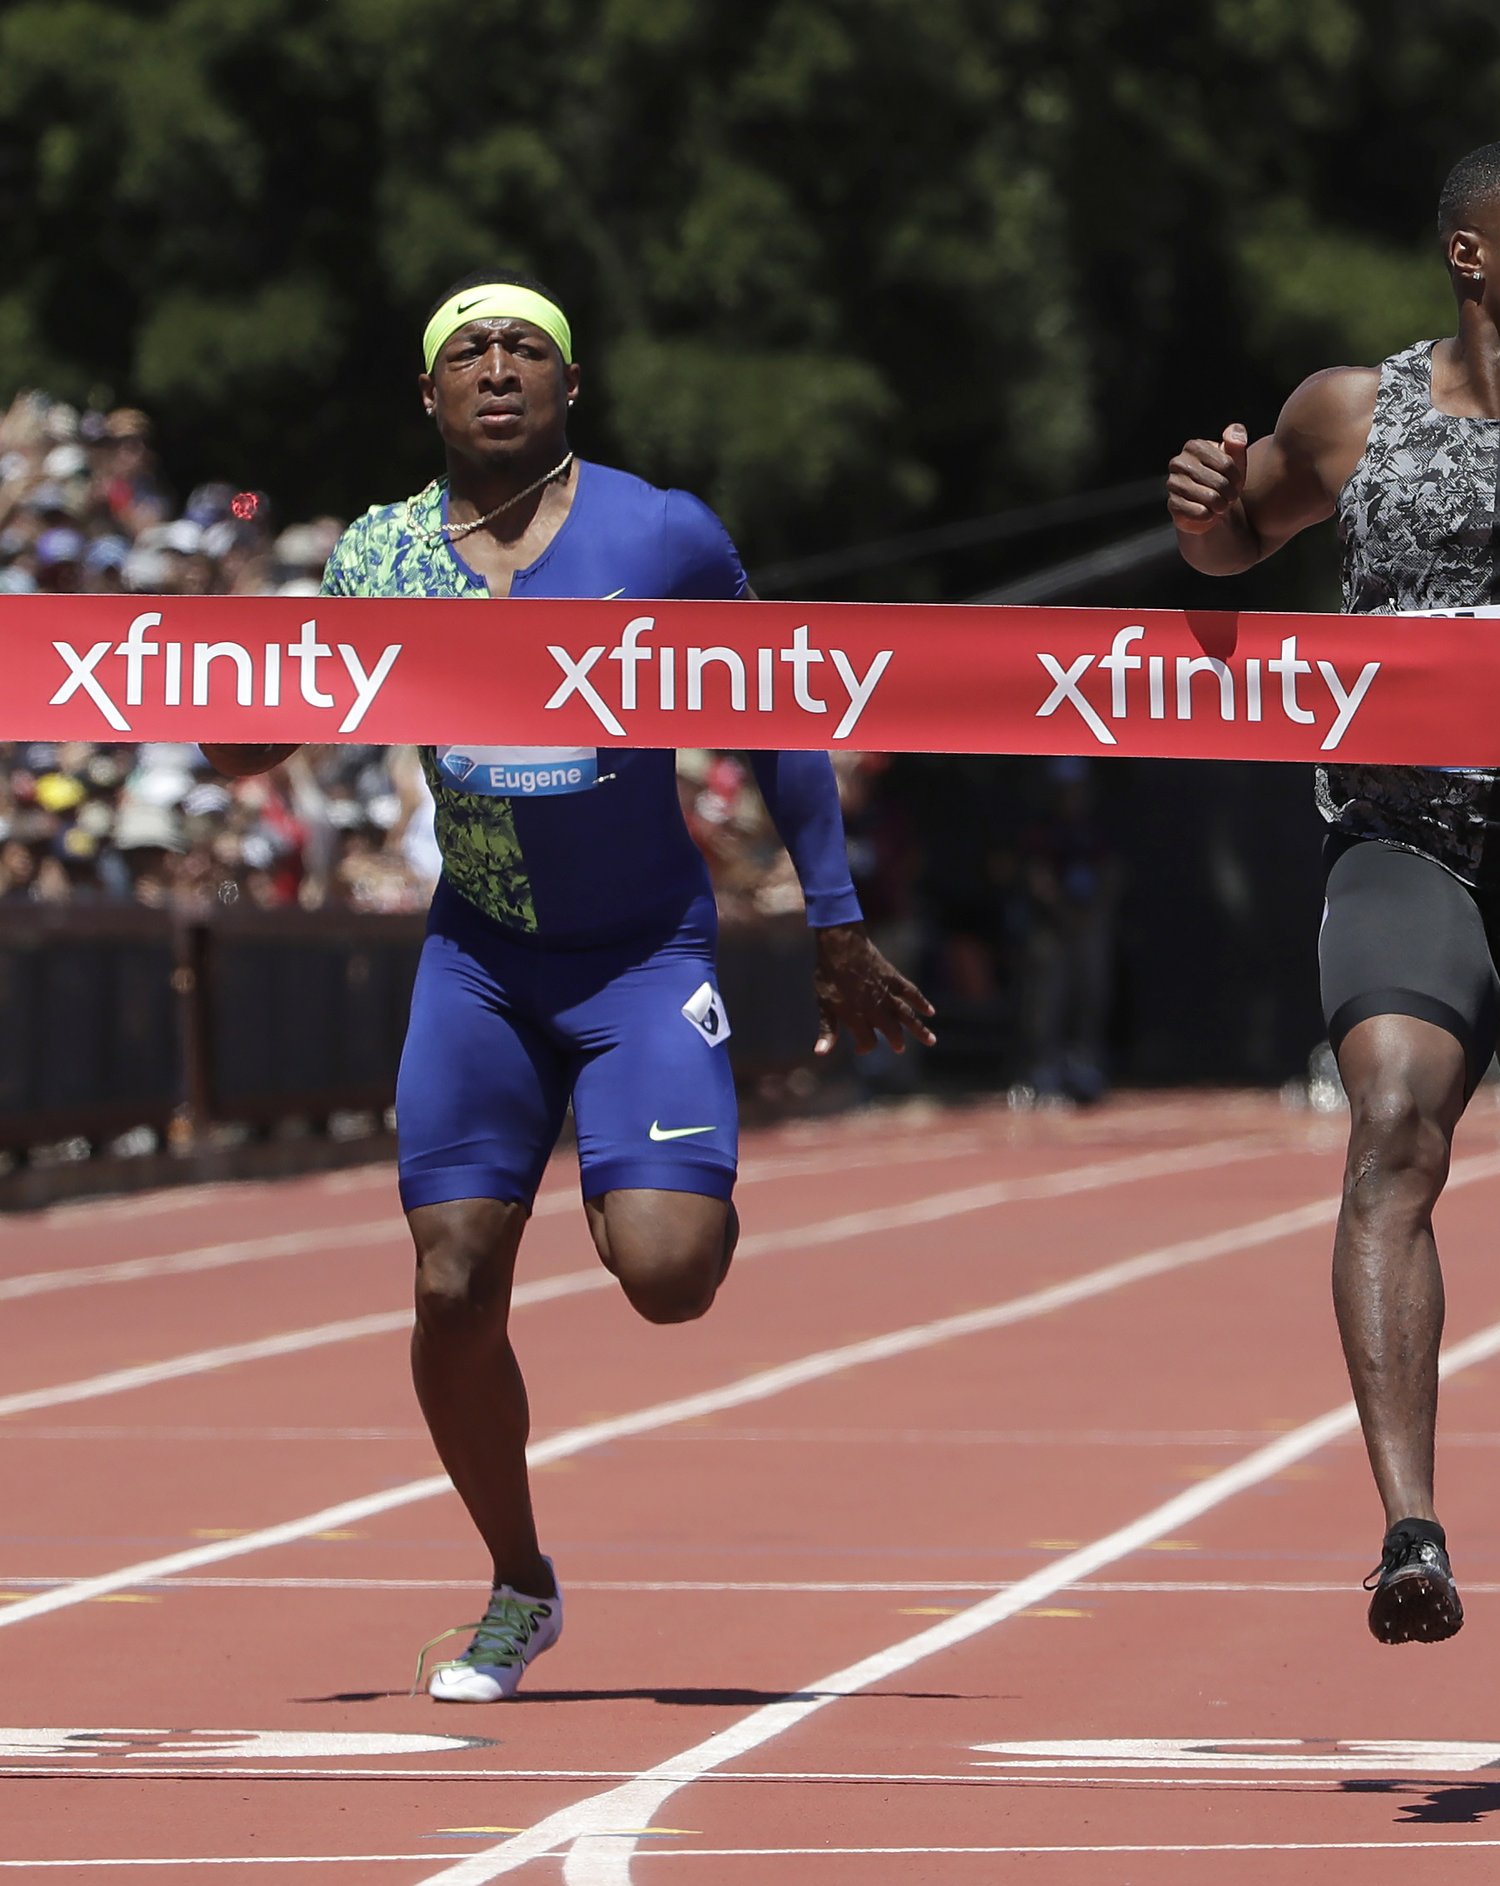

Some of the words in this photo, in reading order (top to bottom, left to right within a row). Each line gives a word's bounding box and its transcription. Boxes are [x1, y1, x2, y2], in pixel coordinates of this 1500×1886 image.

[48, 612, 403, 734] xfinity
[544, 616, 894, 739] xfinity
[1035, 625, 1381, 750] xfinity
[489, 767, 582, 793] Eugene
